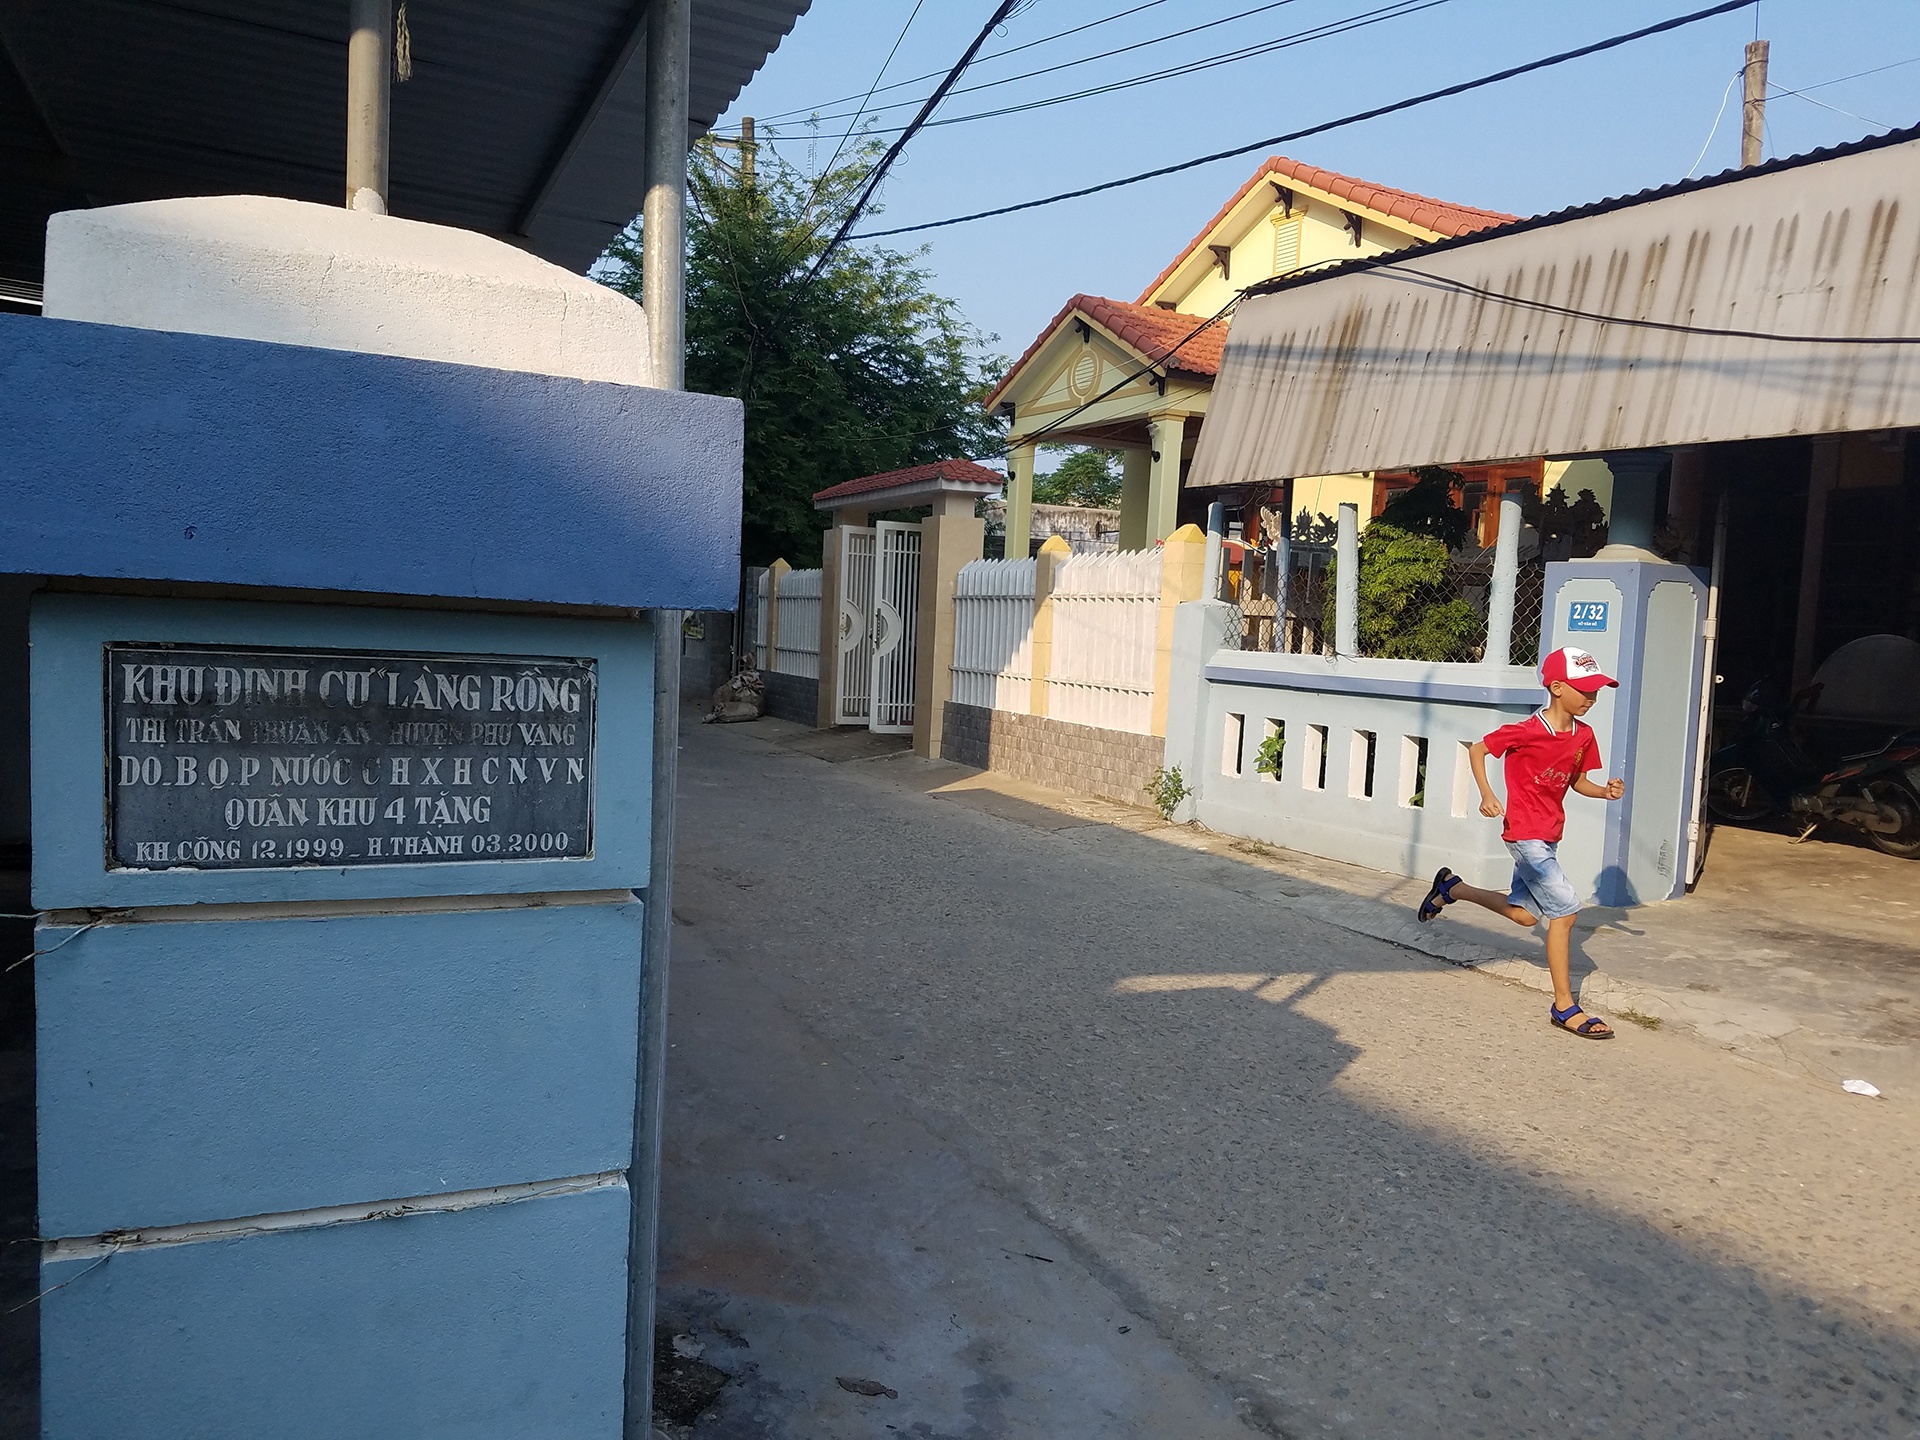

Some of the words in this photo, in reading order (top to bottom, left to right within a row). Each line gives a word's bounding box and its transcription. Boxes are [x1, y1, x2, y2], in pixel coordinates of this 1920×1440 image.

[1573, 604, 1604, 620] 2/32
[121, 663, 206, 706] KHU
[318, 667, 376, 709] CƯ
[125, 717, 167, 748] THỊ
[175, 709, 241, 744] TRẤN
[517, 721, 577, 747] VANG
[270, 750, 352, 787] NƯỚC
[317, 796, 378, 827] KHU
[383, 797, 407, 825] 4
[414, 790, 492, 828] TẶNG
[471, 832, 569, 853] 03.2000
